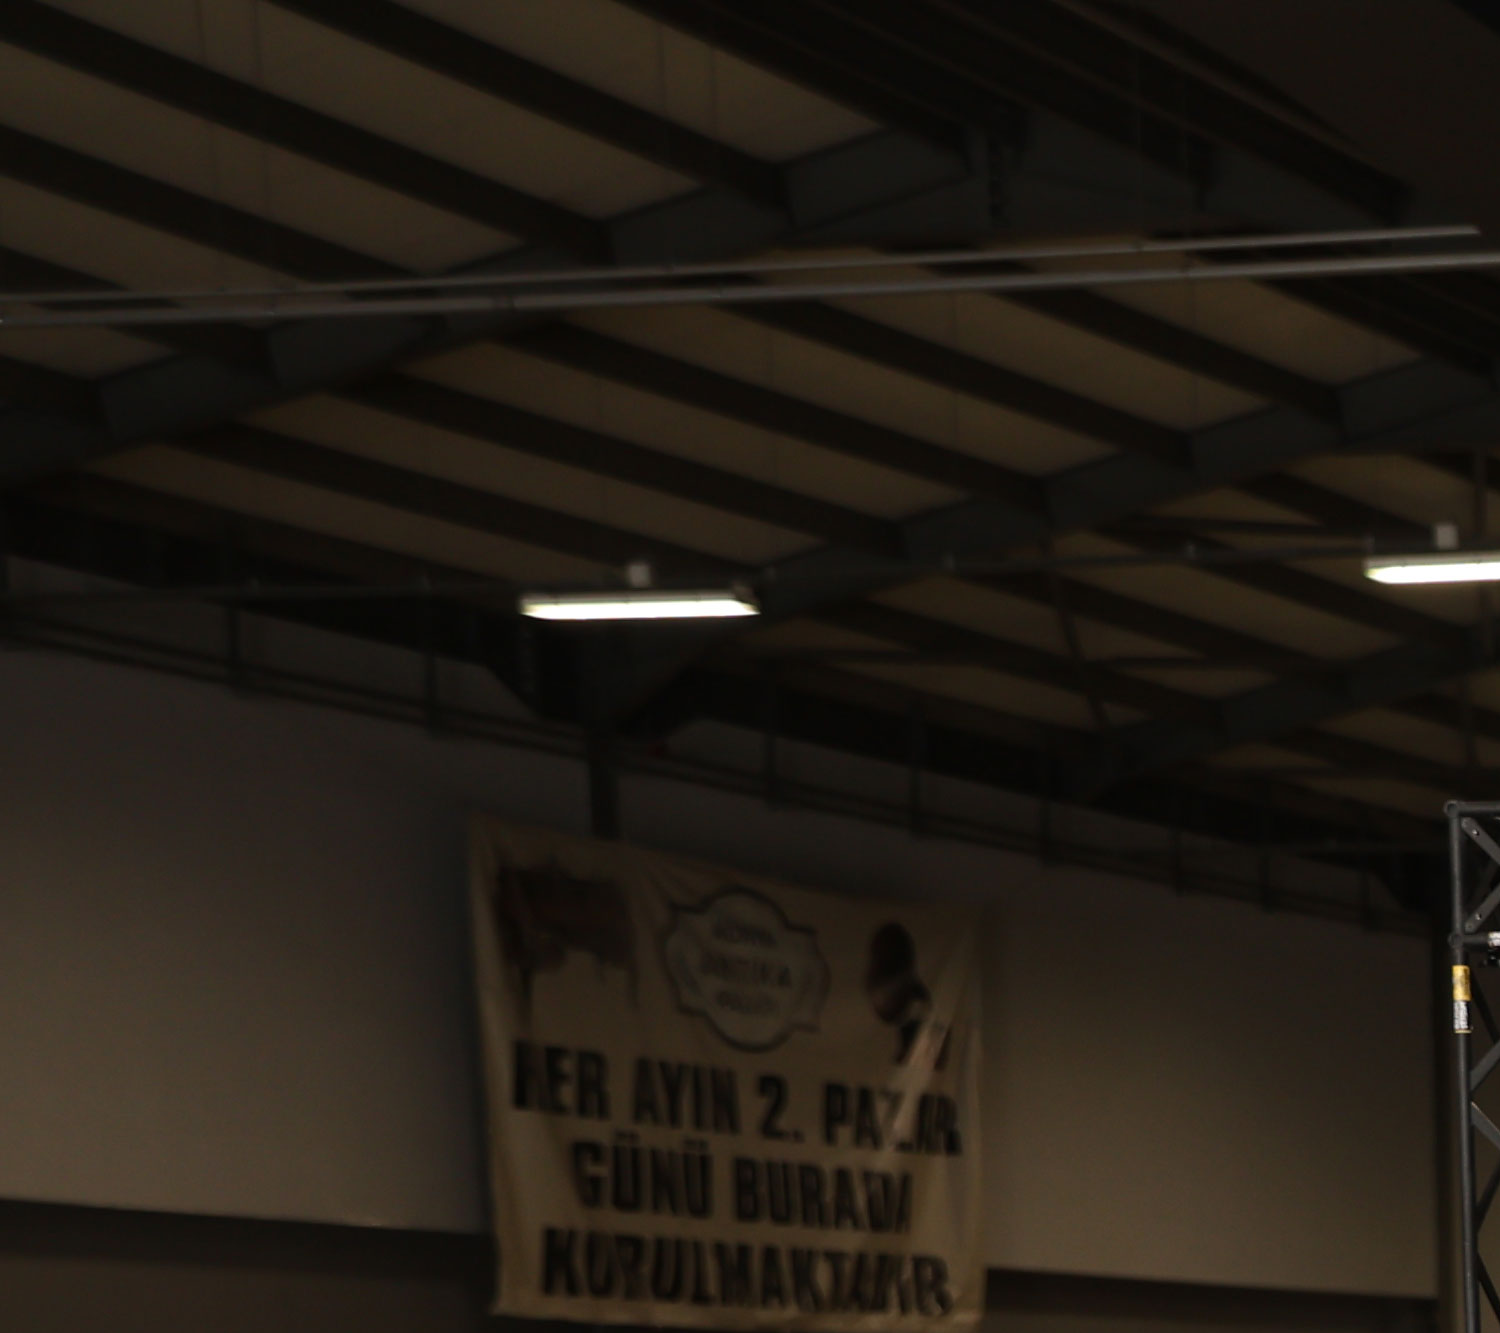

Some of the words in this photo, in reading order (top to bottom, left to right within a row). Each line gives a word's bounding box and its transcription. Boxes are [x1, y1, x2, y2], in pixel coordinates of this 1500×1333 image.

[634, 1058, 739, 1135] AYIN
[758, 1073, 804, 1143] 2.
[571, 1130, 713, 1218] GÜNÜ
